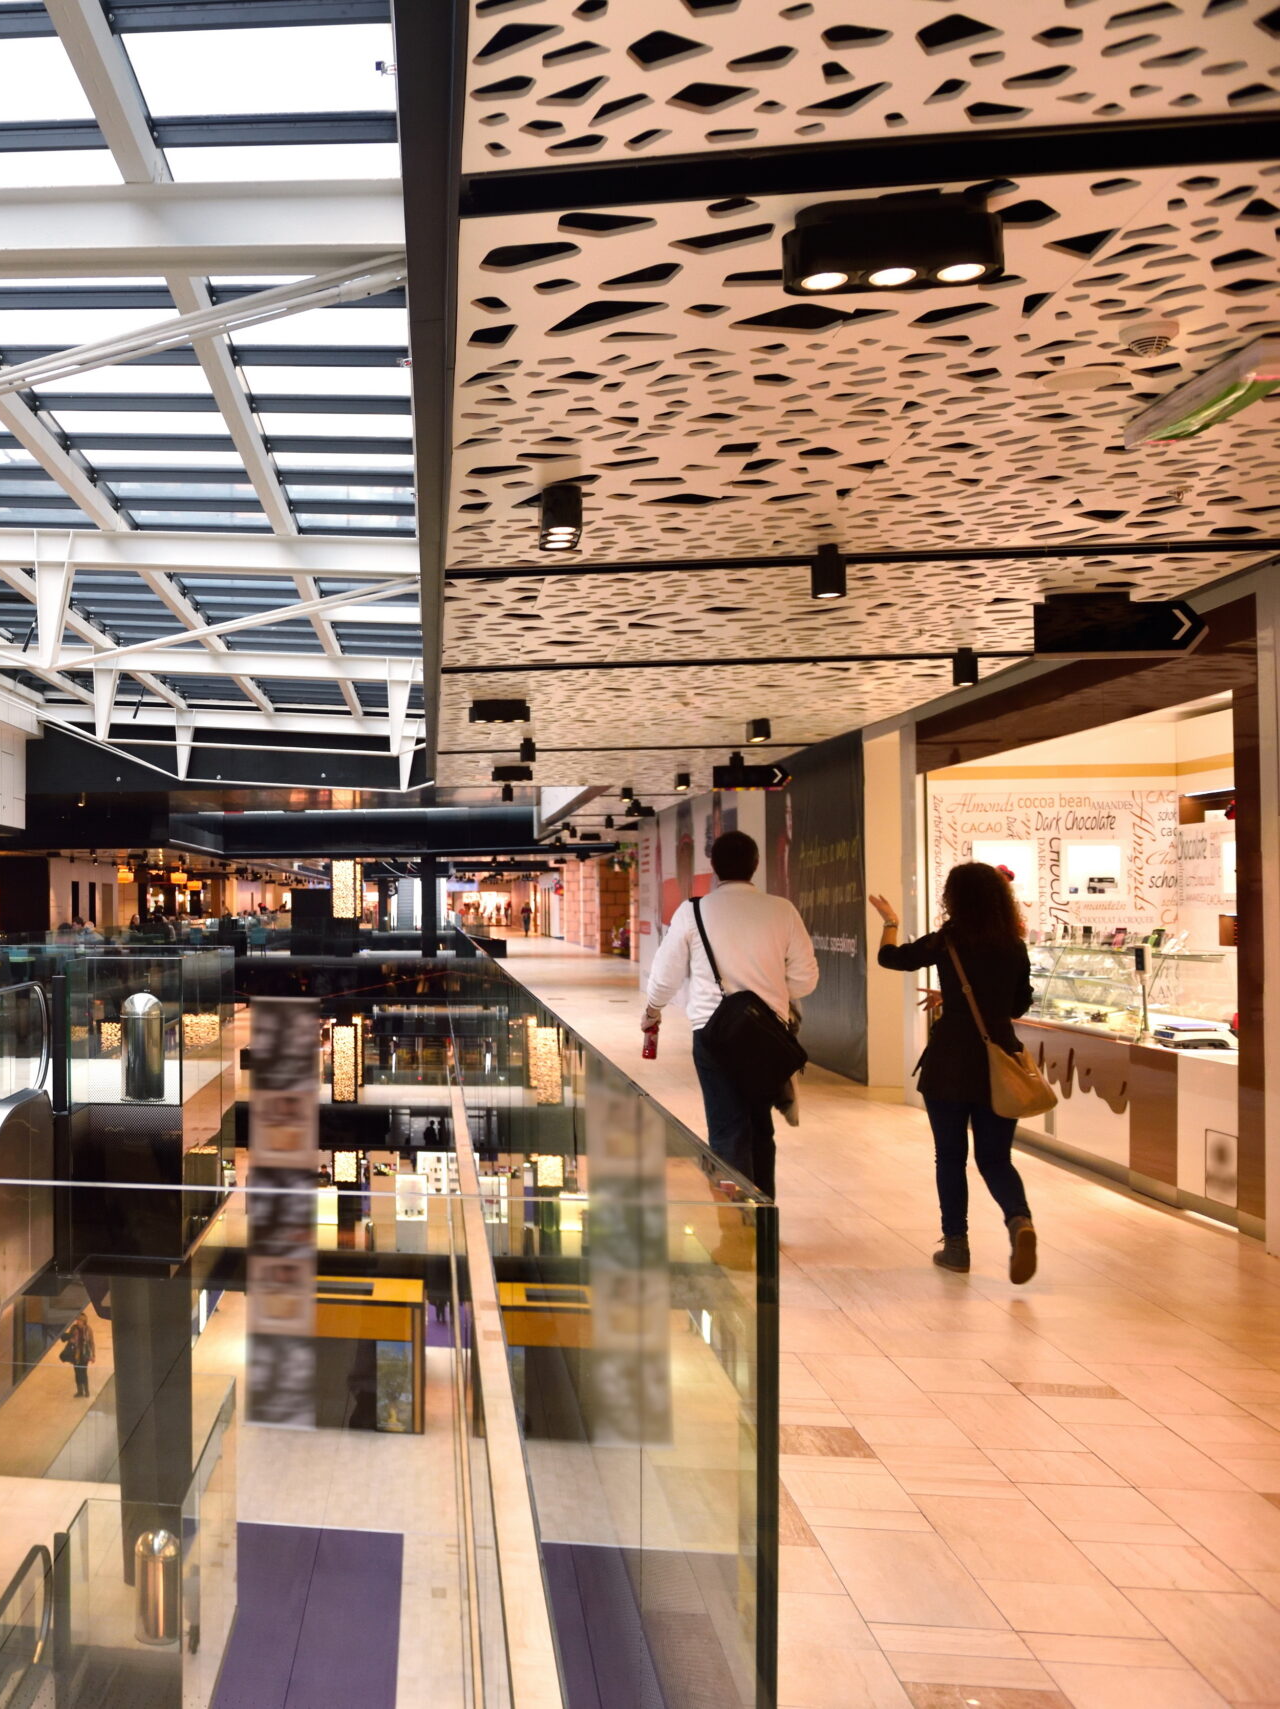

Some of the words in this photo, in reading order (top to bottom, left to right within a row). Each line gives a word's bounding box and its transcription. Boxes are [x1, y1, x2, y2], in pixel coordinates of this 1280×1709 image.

[946, 792, 1014, 814] Almonds
[1017, 797, 1056, 809] cocoa
[1059, 792, 1091, 809] bean
[1091, 800, 1134, 811] AMANDES
[960, 822, 1003, 834] CACAO
[1035, 810, 1062, 834] Dark
[1064, 810, 1117, 832] Chocolate
[387, 882, 396, 896] 3
